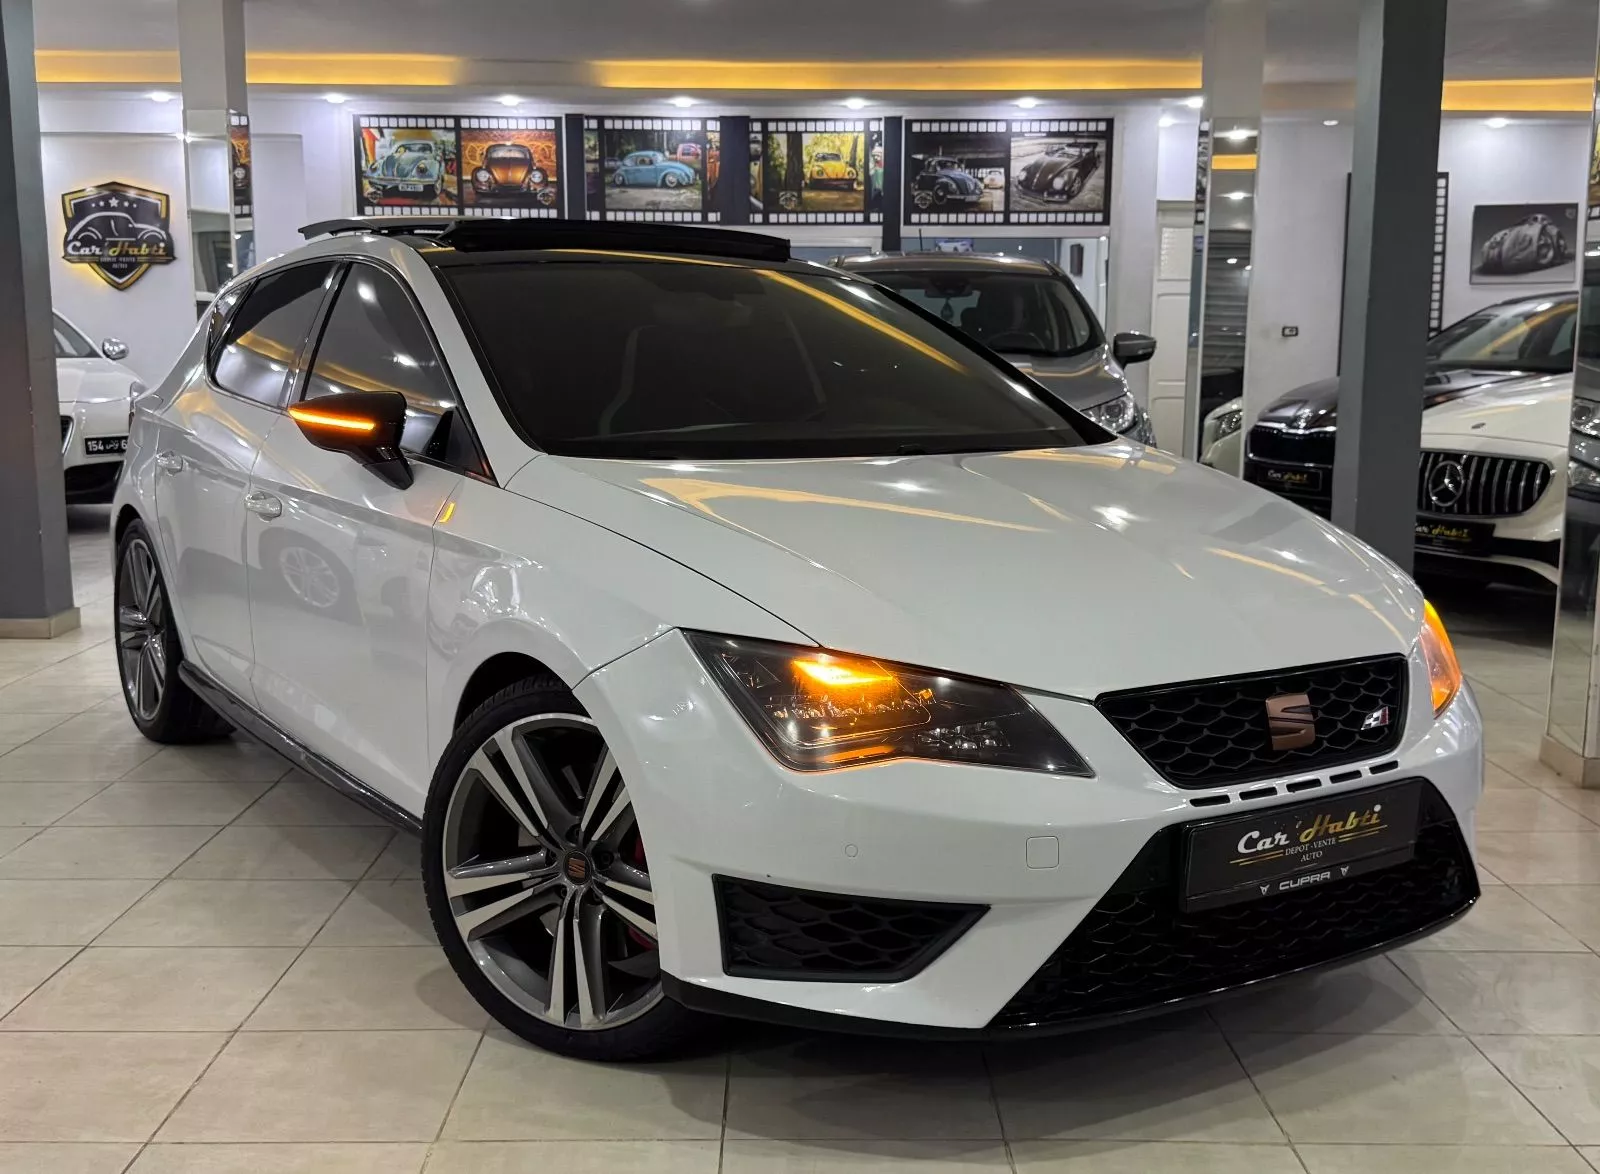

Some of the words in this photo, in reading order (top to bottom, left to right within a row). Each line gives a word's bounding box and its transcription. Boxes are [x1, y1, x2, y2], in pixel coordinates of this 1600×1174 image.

[67, 241, 102, 255] Car
[87, 441, 104, 452] 154
[1237, 830, 1290, 853] Car
[1300, 850, 1323, 862] AUTO
[1279, 871, 1331, 891] CUPRA
